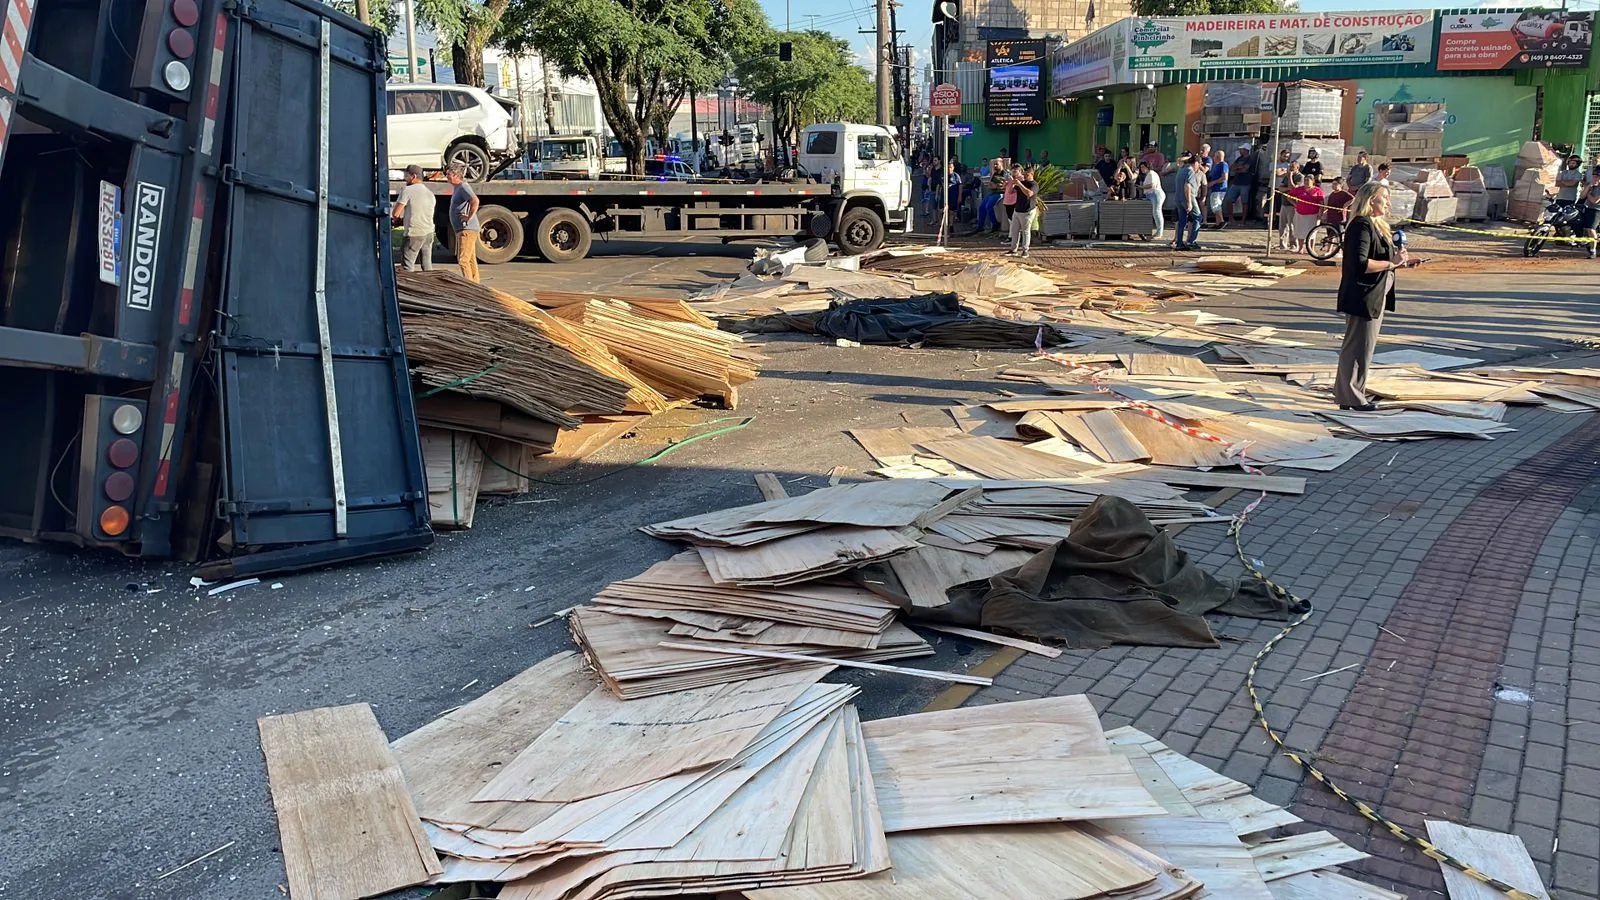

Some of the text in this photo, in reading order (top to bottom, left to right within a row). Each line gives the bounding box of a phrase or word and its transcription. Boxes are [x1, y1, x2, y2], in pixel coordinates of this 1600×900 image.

[1186, 12, 1424, 31] MADEIREIRA E MAT. DE CONSTRUÇÃO
[932, 90, 959, 98] eston
[934, 97, 957, 105] hotel
[132, 187, 160, 305] RANDON
